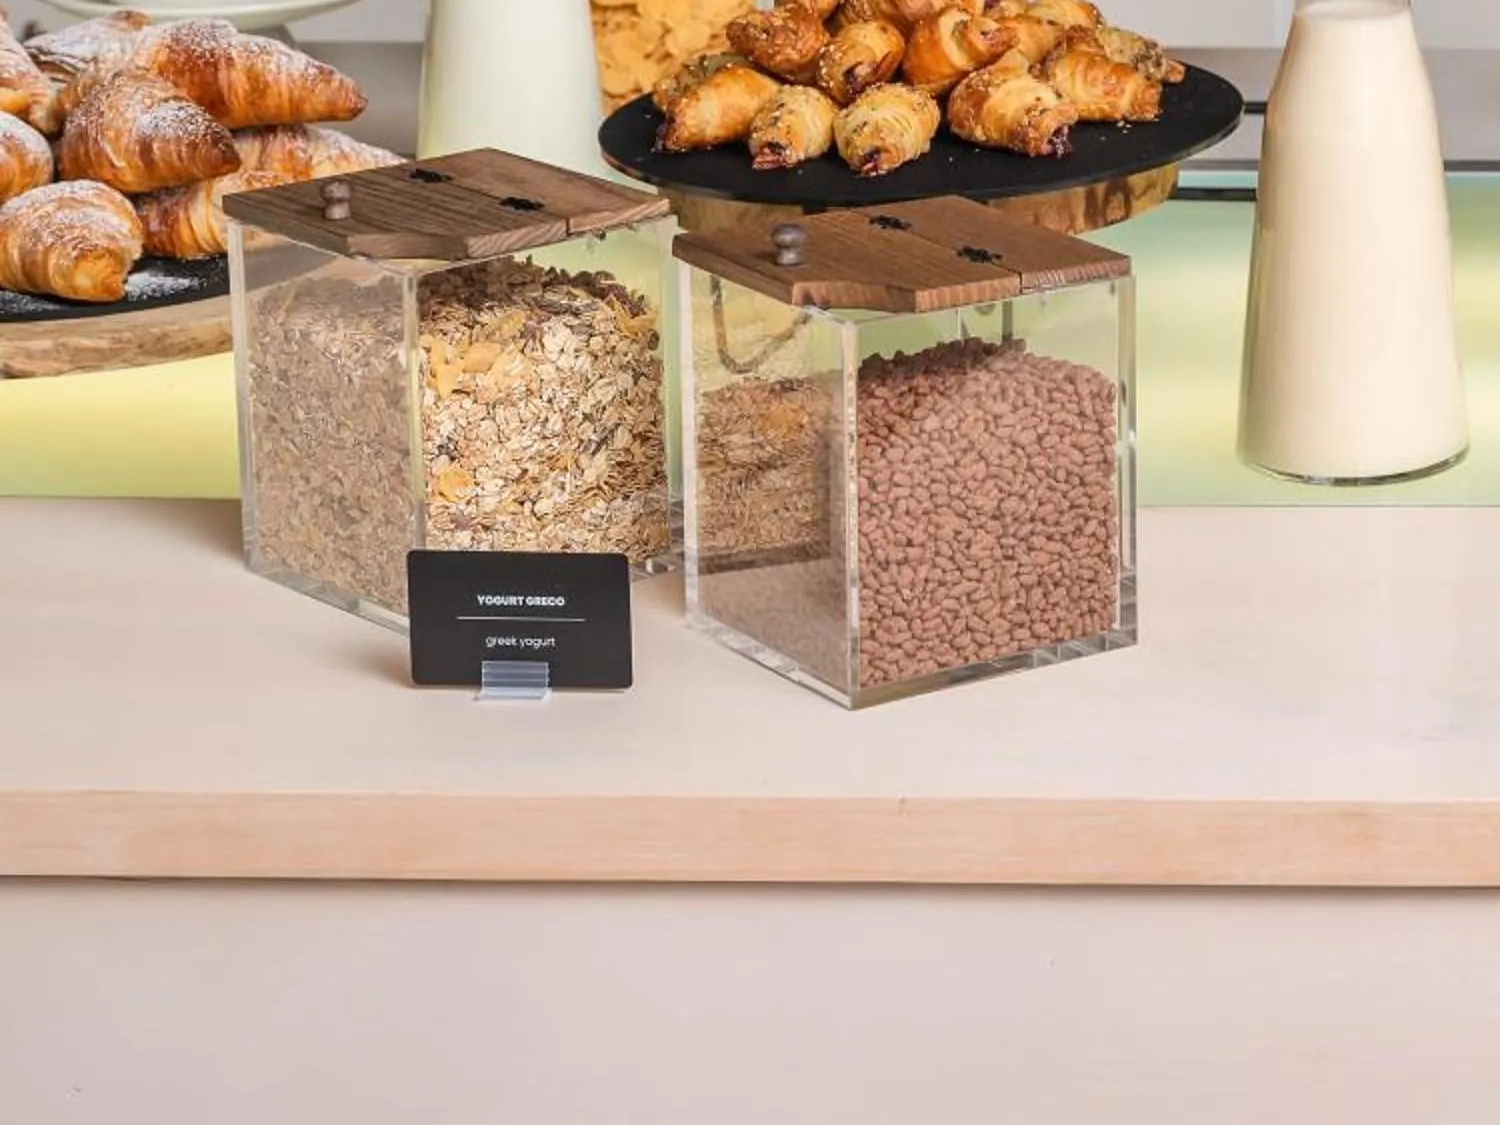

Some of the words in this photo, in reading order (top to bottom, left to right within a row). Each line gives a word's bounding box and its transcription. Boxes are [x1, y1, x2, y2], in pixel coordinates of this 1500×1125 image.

[477, 594, 525, 606] YOGURT
[526, 595, 565, 606] GRECO
[485, 636, 518, 648] greek
[519, 636, 556, 649] yogurt
